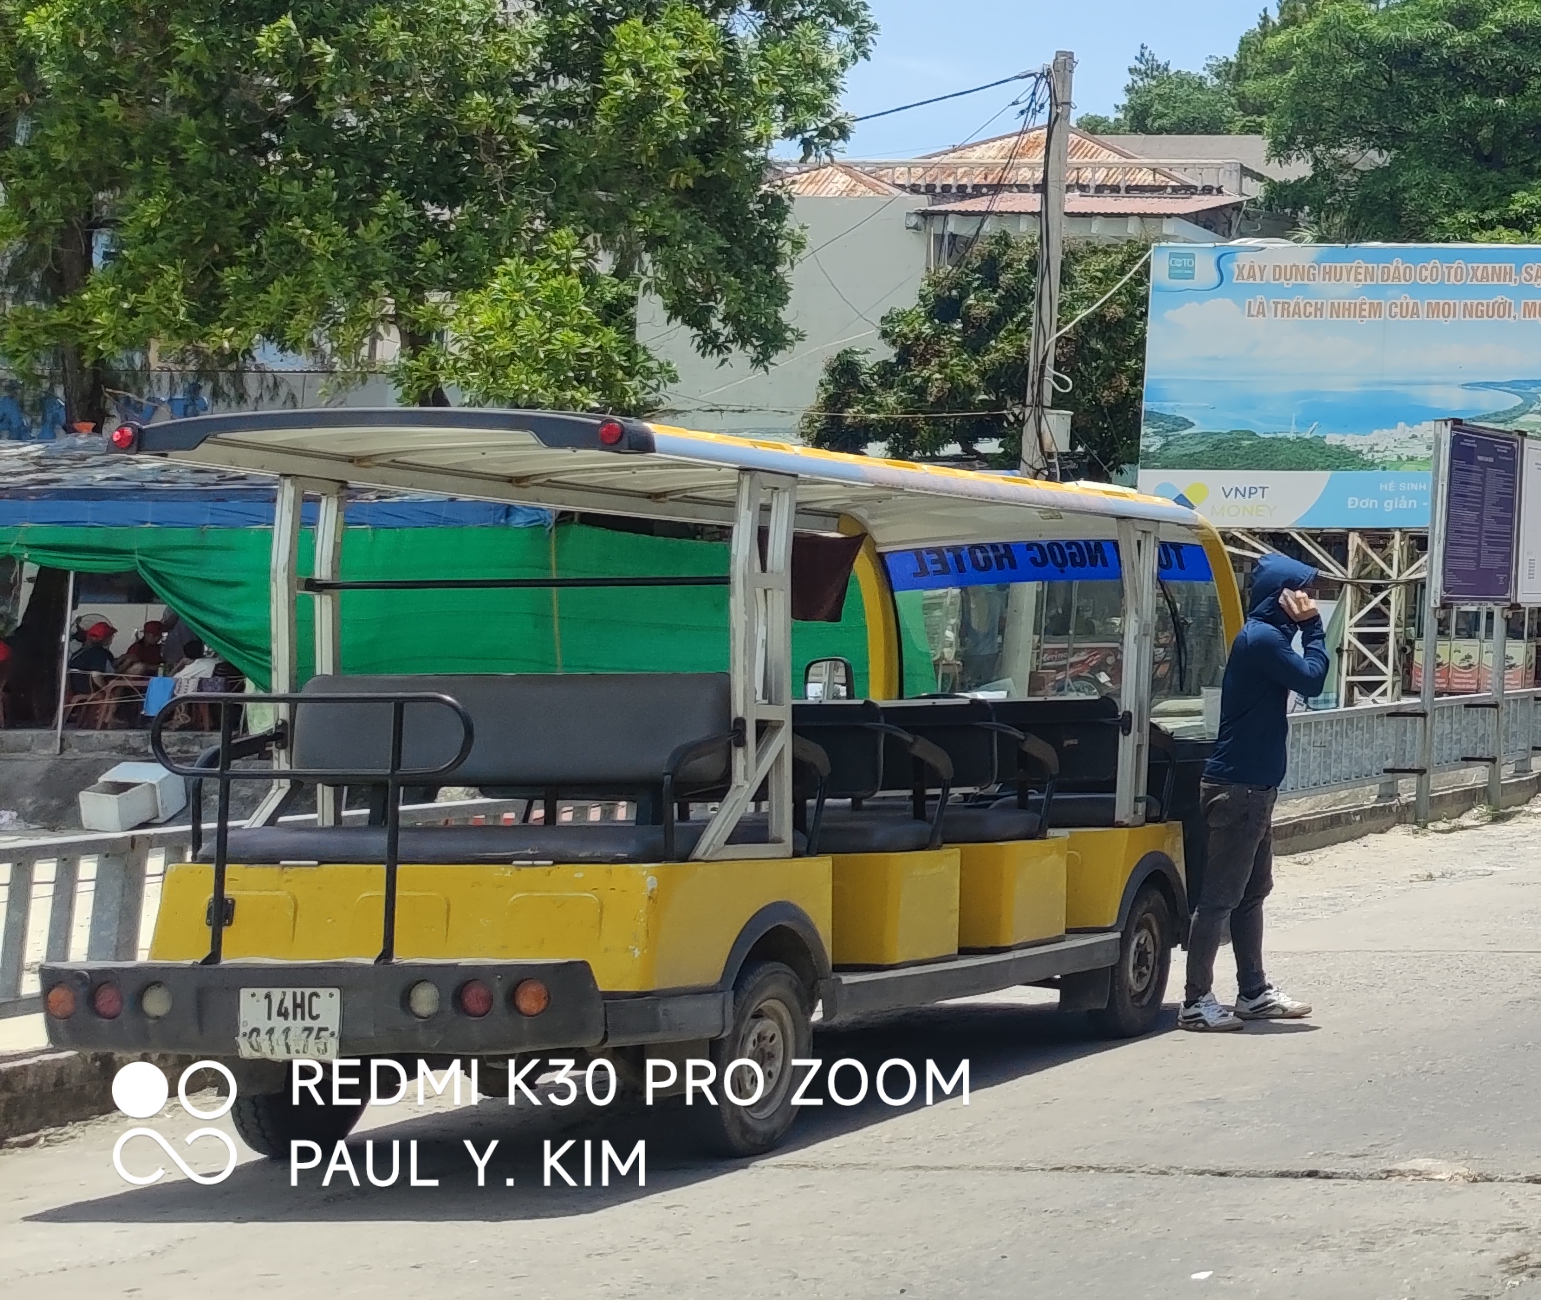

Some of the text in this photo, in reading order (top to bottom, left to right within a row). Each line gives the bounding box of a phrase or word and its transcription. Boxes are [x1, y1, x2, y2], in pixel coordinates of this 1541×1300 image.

[1235, 261, 1267, 282] XÂY
[1273, 263, 1317, 286] DỰNG
[1322, 260, 1375, 286] HUYỆN
[1380, 258, 1412, 283] ĐẢO
[1418, 260, 1440, 283] CÔ
[1444, 260, 1465, 283] TÔ
[1469, 264, 1518, 285] XANH,
[1246, 296, 1266, 318] LÀ
[1272, 296, 1324, 319] TRÁCH
[1329, 297, 1382, 323] NHIỆM
[1389, 295, 1420, 319] CỦA
[1426, 301, 1457, 322] MỌI
[1463, 297, 1517, 321] NGƯỜI,
[1221, 486, 1269, 500] VNPT
[1399, 482, 1427, 491] SINH
[1210, 504, 1278, 517] MONEY
[264, 990, 321, 1021] 14HC
